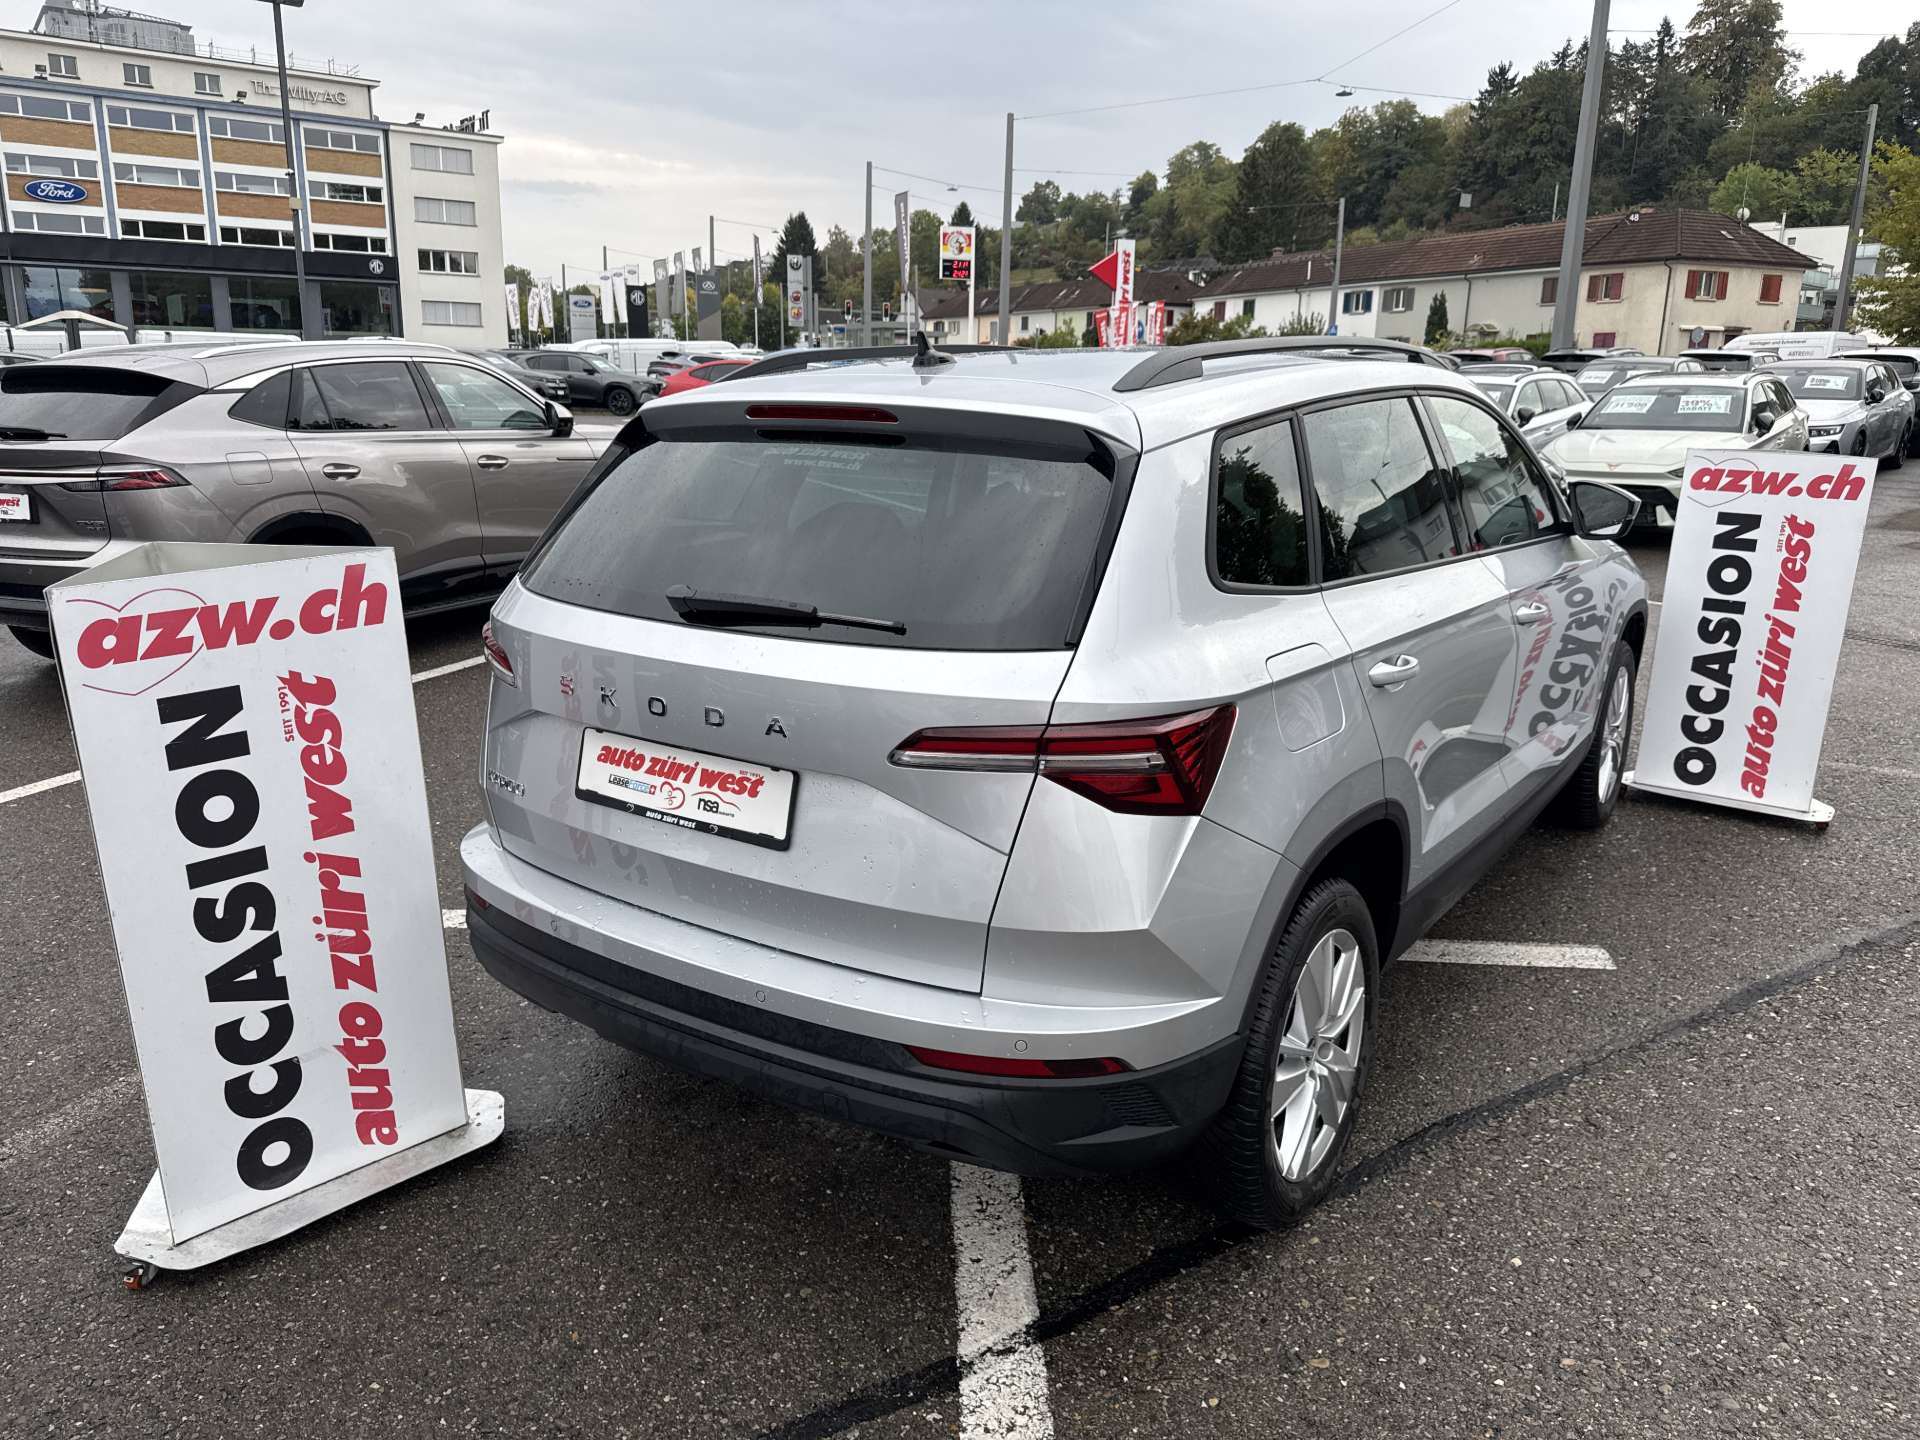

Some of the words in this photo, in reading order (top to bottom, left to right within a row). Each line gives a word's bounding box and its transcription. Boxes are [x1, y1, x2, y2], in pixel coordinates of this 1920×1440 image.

[323, 92, 347, 105] AG
[37, 182, 75, 198] Ford
[1629, 213, 1640, 222] 48
[369, 259, 385, 275] MG
[630, 289, 645, 306] MG
[1690, 464, 1866, 501] azw.ch
[1772, 514, 1815, 612] west
[77, 563, 388, 669] azw.ch
[1673, 511, 1762, 786] OCCASION
[1756, 613, 1796, 707] züri
[277, 686, 290, 715] 1991
[282, 718, 295, 743] SEIT
[1740, 705, 1778, 799] auto
[276, 670, 356, 842] west
[596, 744, 646, 772] auto
[645, 755, 700, 785] züri
[700, 767, 765, 799] west
[645, 810, 662, 820] auto
[661, 814, 679, 825] züri
[678, 819, 697, 829] west
[697, 797, 720, 814] nsa
[156, 684, 314, 1191] OCCASION
[303, 851, 378, 994] züri
[333, 1001, 399, 1146] auto
